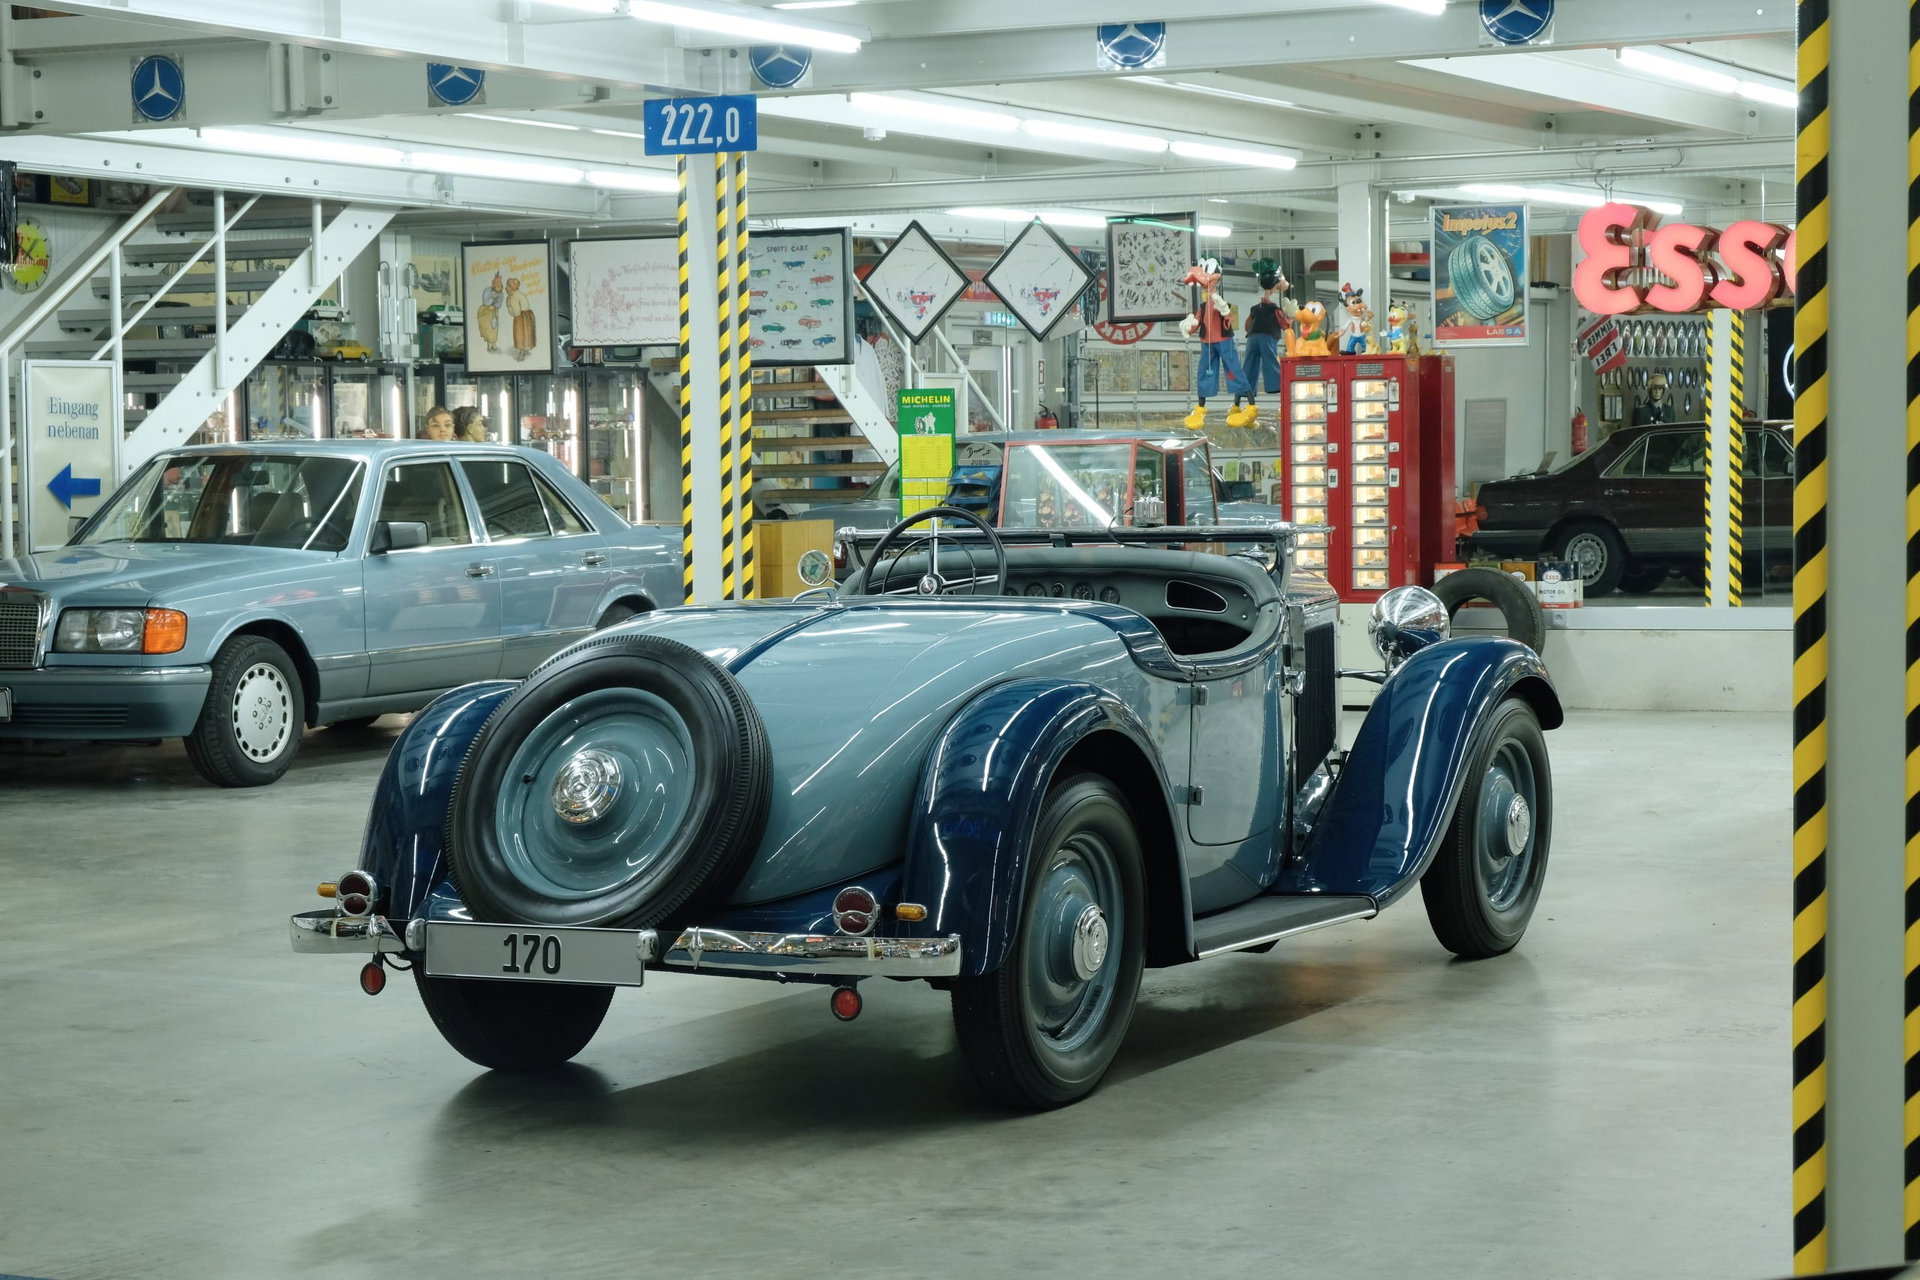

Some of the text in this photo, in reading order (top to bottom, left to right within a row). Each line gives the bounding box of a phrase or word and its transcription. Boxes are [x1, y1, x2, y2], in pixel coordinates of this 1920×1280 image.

[660, 102, 740, 148] 222,0
[790, 244, 809, 252] CARS
[1574, 202, 1796, 314] Ess
[1486, 327, 1522, 336] LASSA
[49, 396, 99, 420] Eingang
[901, 395, 951, 404] MICHELIN
[48, 421, 99, 440] nebenan
[502, 932, 562, 974] 170
